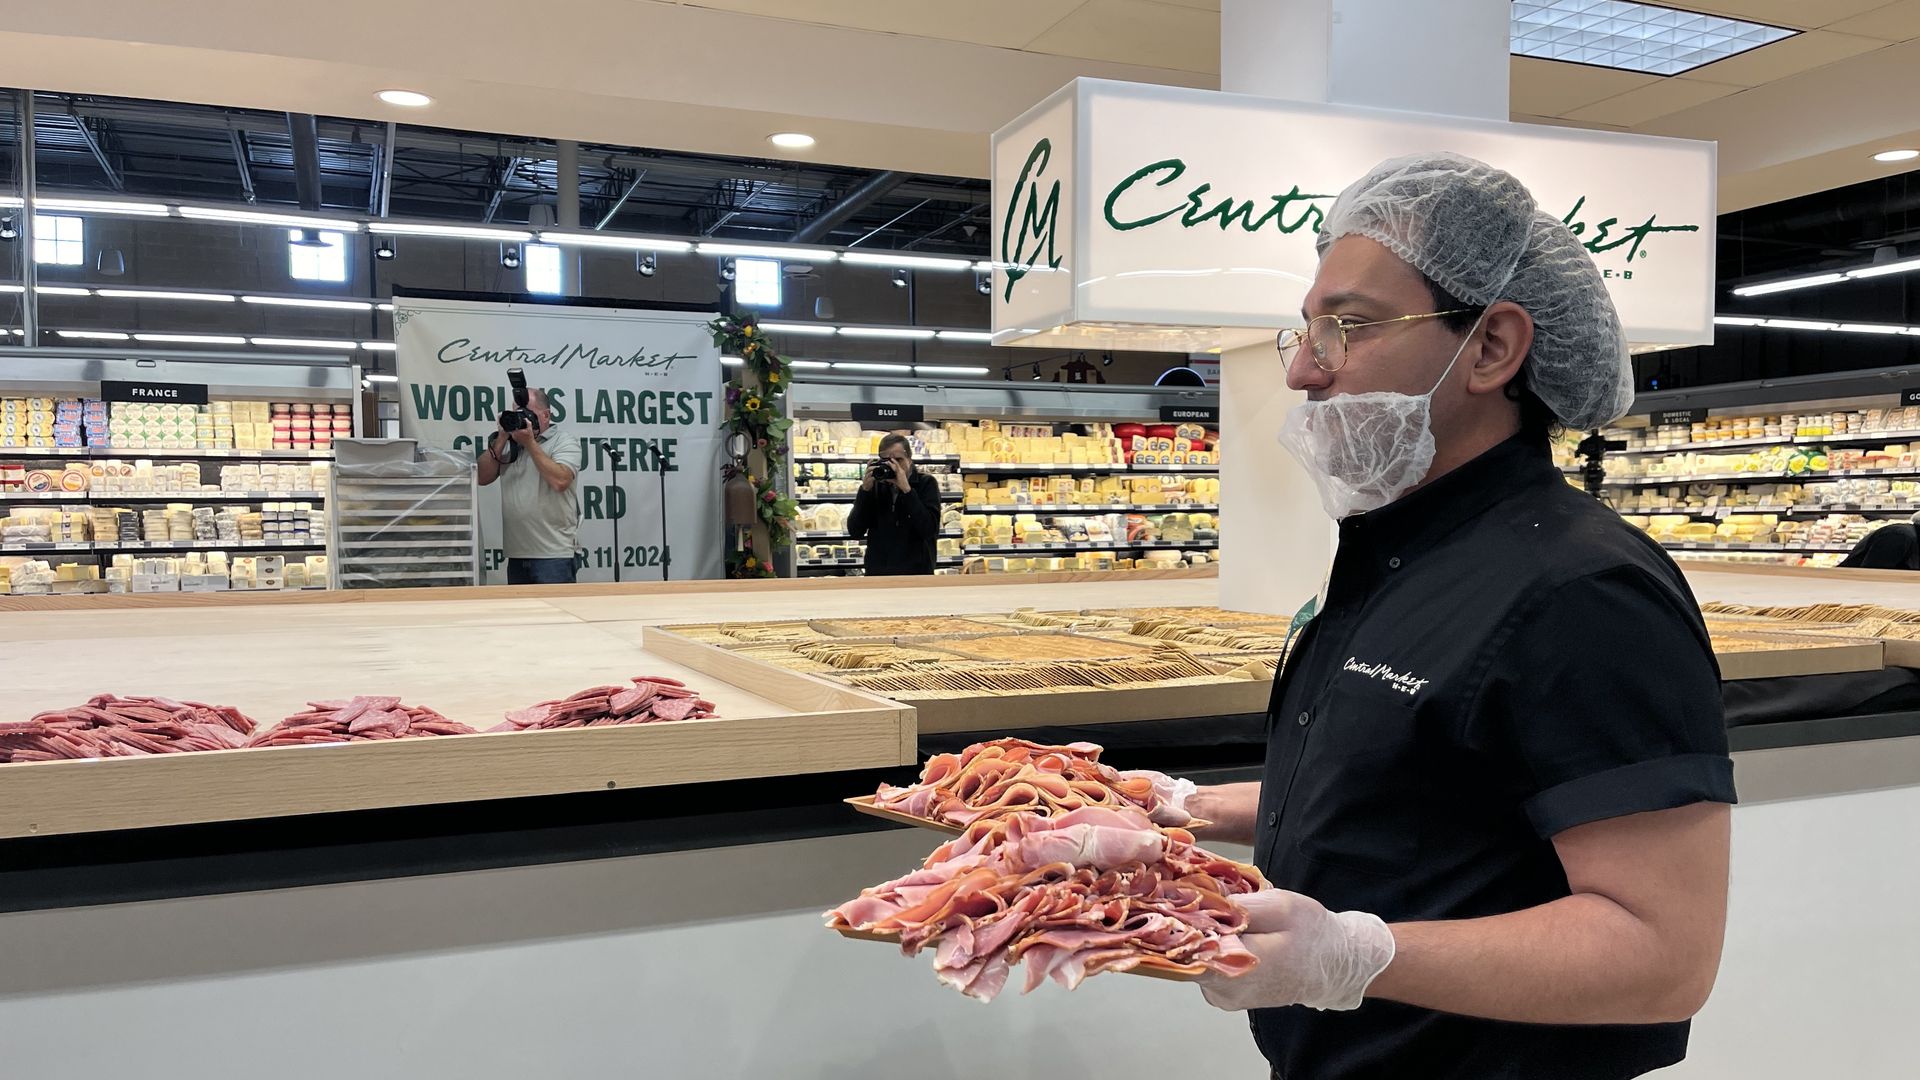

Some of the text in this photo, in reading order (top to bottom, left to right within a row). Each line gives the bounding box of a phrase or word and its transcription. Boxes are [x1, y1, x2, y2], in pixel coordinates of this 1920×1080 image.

[1104, 158, 1339, 235] Centr
[437, 338, 698, 370] Central Market
[131, 388, 178, 398] FRANCE
[410, 383, 713, 425] WORLS LARGEST
[878, 408, 899, 417] BLUE
[1172, 410, 1210, 419] EUROPEAN
[623, 545, 671, 568] 2024
